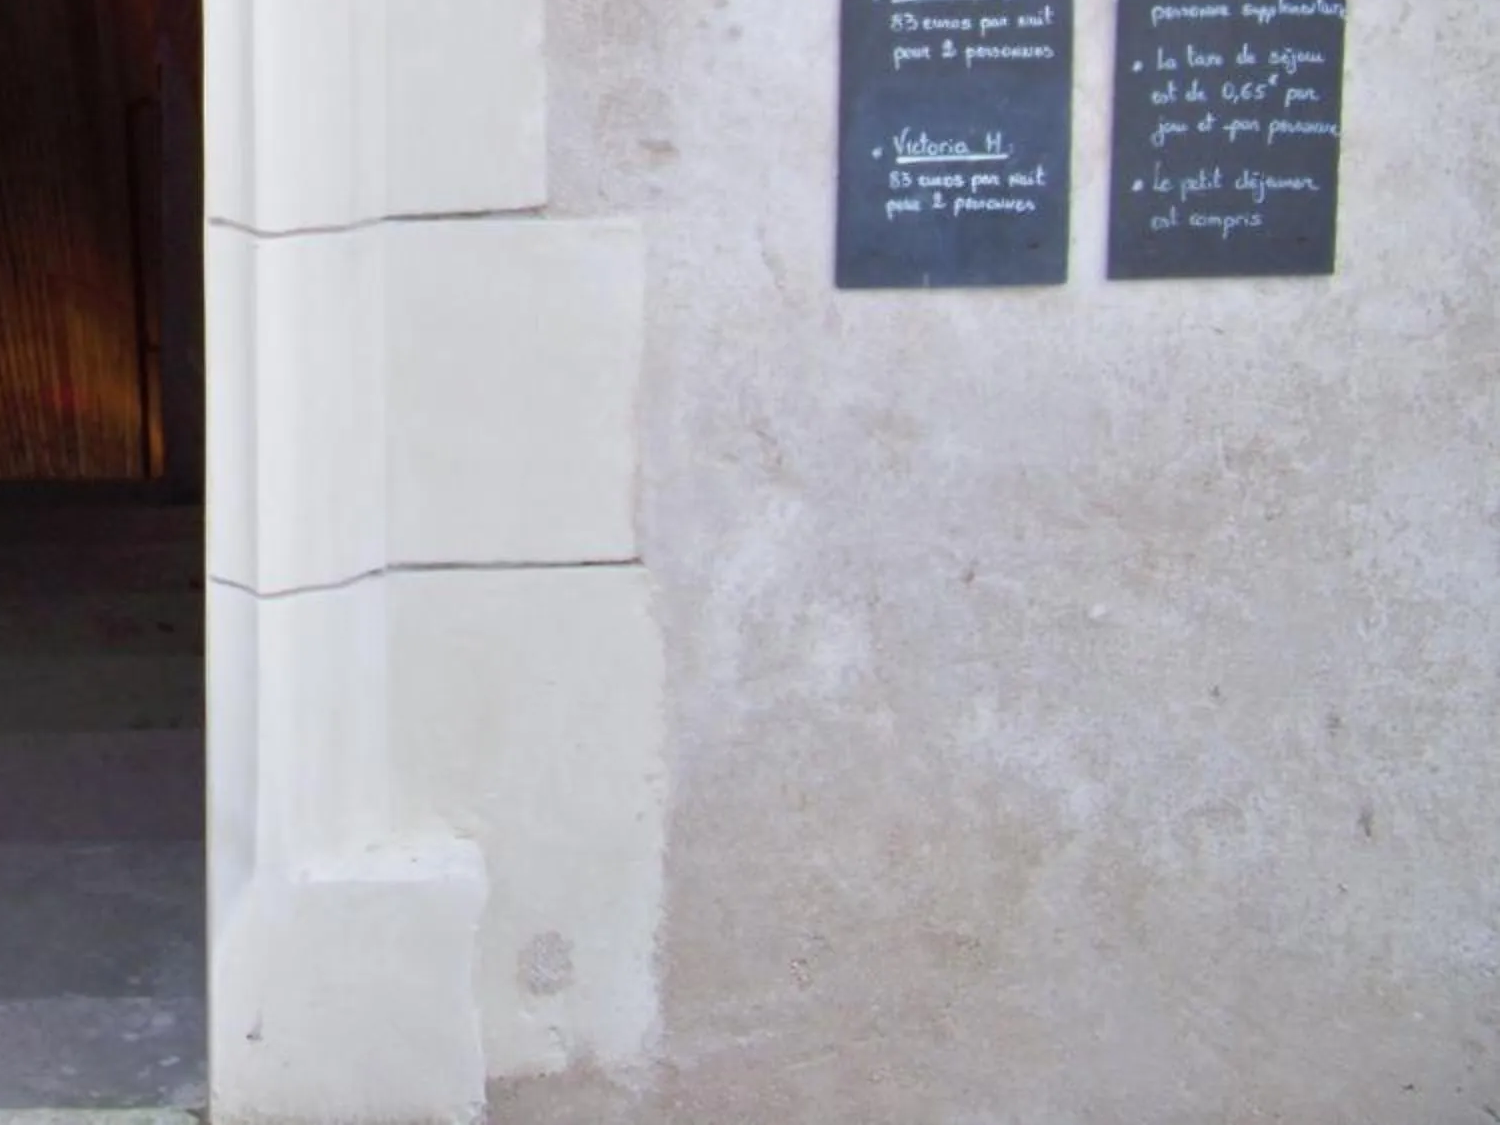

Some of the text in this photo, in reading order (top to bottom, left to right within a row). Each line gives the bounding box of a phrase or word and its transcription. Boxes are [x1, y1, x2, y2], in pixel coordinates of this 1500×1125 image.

[923, 16, 971, 30] euros
[980, 17, 1008, 37] par
[1151, 5, 1230, 27] personne
[893, 39, 1054, 70] pour 2 personnes
[1236, 43, 1255, 65] de
[1152, 80, 1177, 105] est
[1185, 79, 1207, 102] de
[1285, 88, 1319, 107] par
[1197, 112, 1217, 132] et
[893, 128, 968, 155] Victoria
[918, 174, 965, 187] euros
[971, 175, 1000, 194] par
[1181, 166, 1222, 202] petit
[1235, 171, 1320, 203] déjeuner
[932, 192, 946, 209] 2
[954, 198, 1035, 216] personnes
[1151, 206, 1262, 239] est compris
